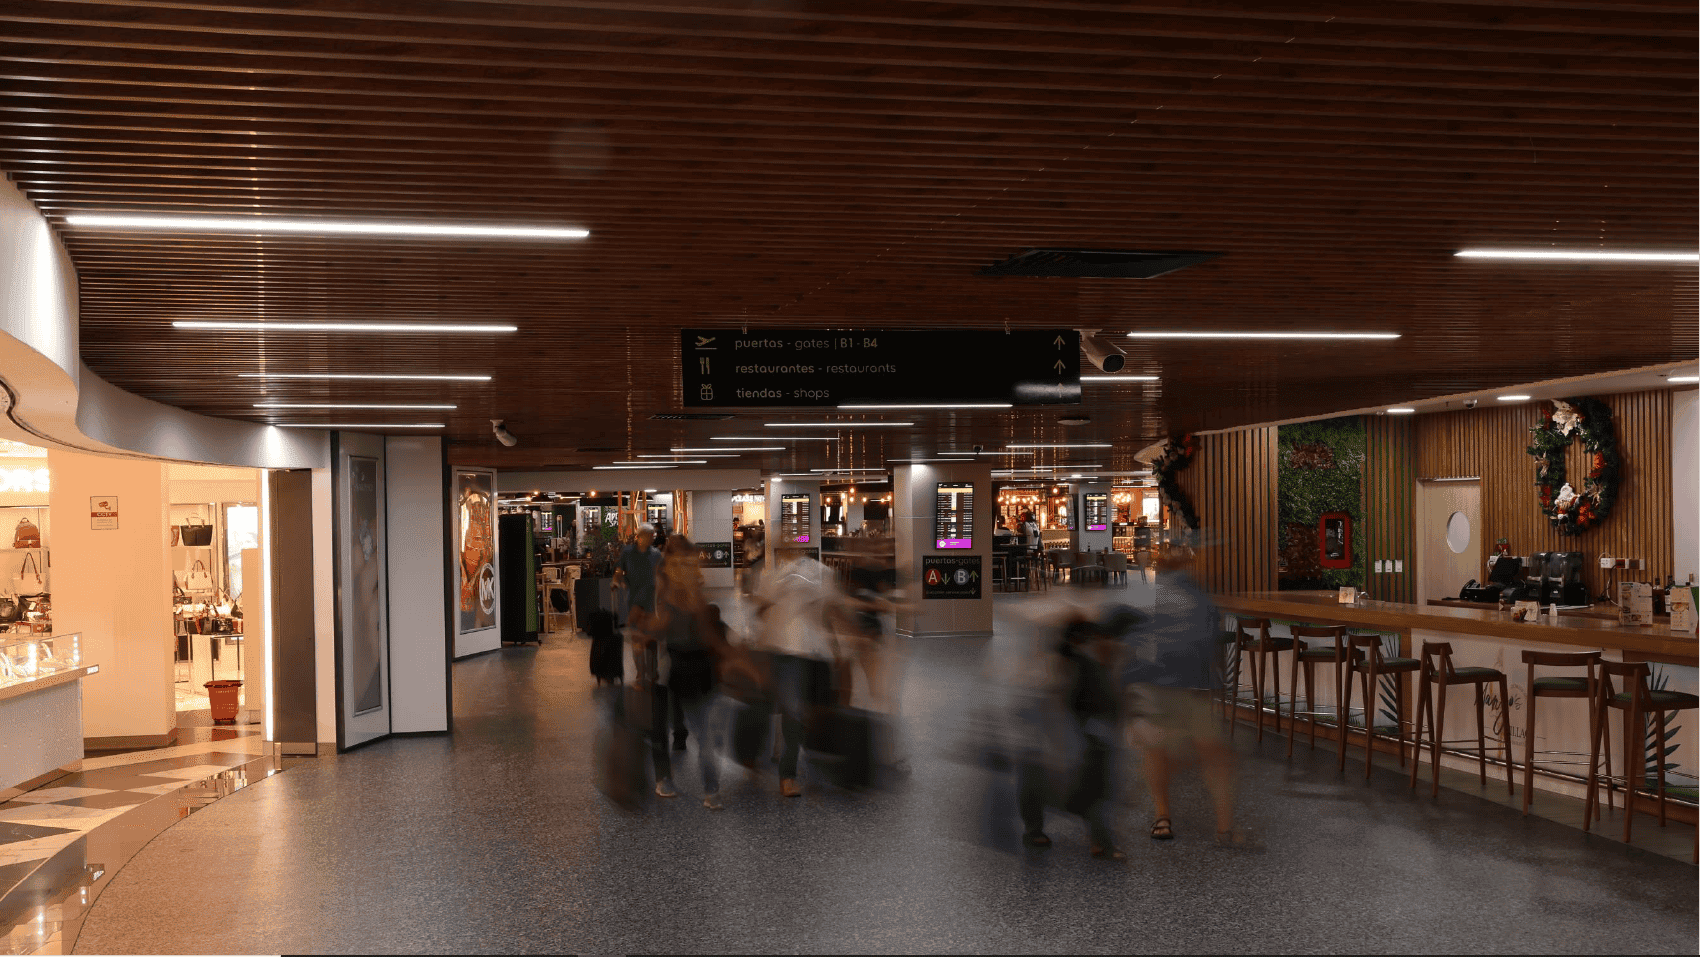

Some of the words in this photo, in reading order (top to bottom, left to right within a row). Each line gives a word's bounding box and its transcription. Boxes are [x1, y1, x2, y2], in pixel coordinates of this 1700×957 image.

[735, 338, 783, 350] puertas
[795, 338, 830, 350] gates
[840, 338, 853, 348] B1
[863, 338, 878, 348] B4
[735, 364, 815, 373] restaurantes
[826, 363, 897, 373] restaurants
[736, 388, 782, 398] tiendas
[794, 388, 830, 400] shops
[716, 550, 722, 559] B
[928, 570, 938, 583] A
[957, 570, 966, 583] B
